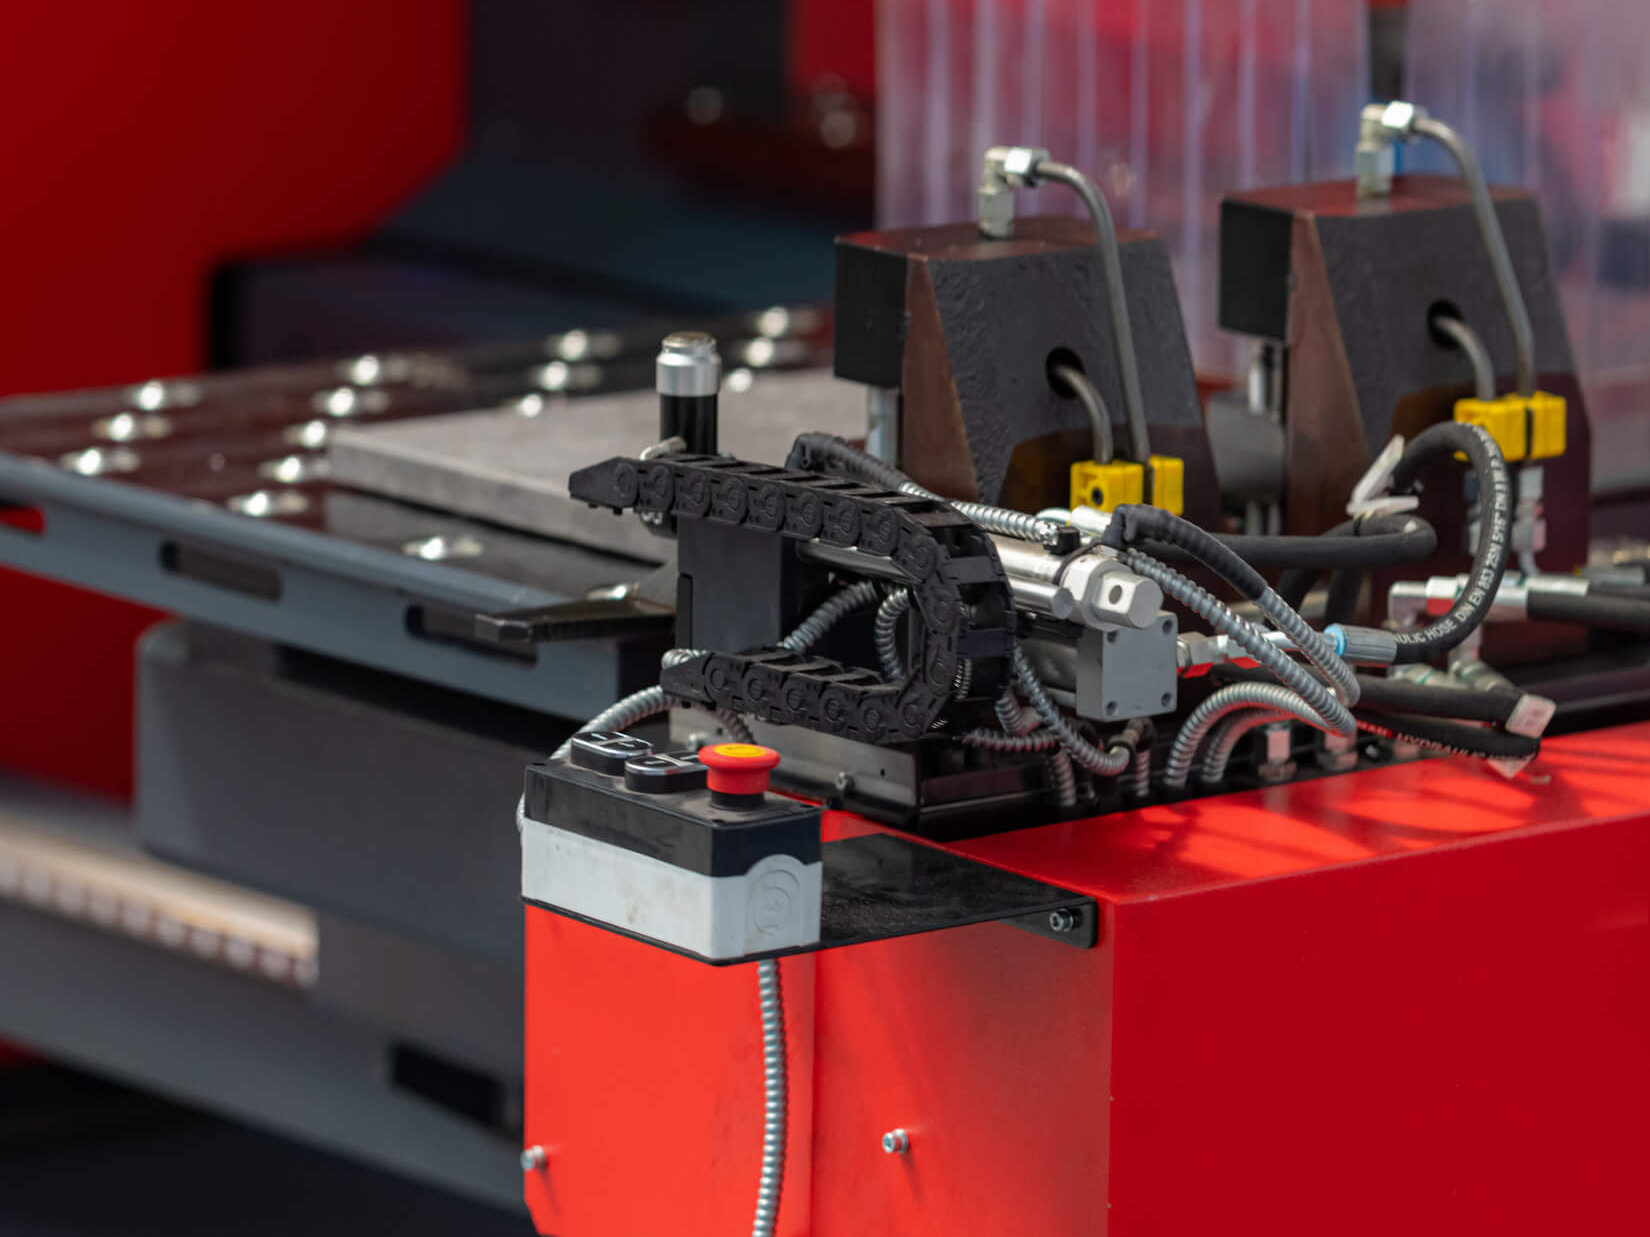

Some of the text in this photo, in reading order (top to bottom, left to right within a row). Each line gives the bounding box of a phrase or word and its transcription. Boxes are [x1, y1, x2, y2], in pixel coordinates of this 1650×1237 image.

[1425, 619, 1457, 640] HOSE
[1455, 604, 1475, 622] DIN
[1469, 587, 1486, 603] EN
